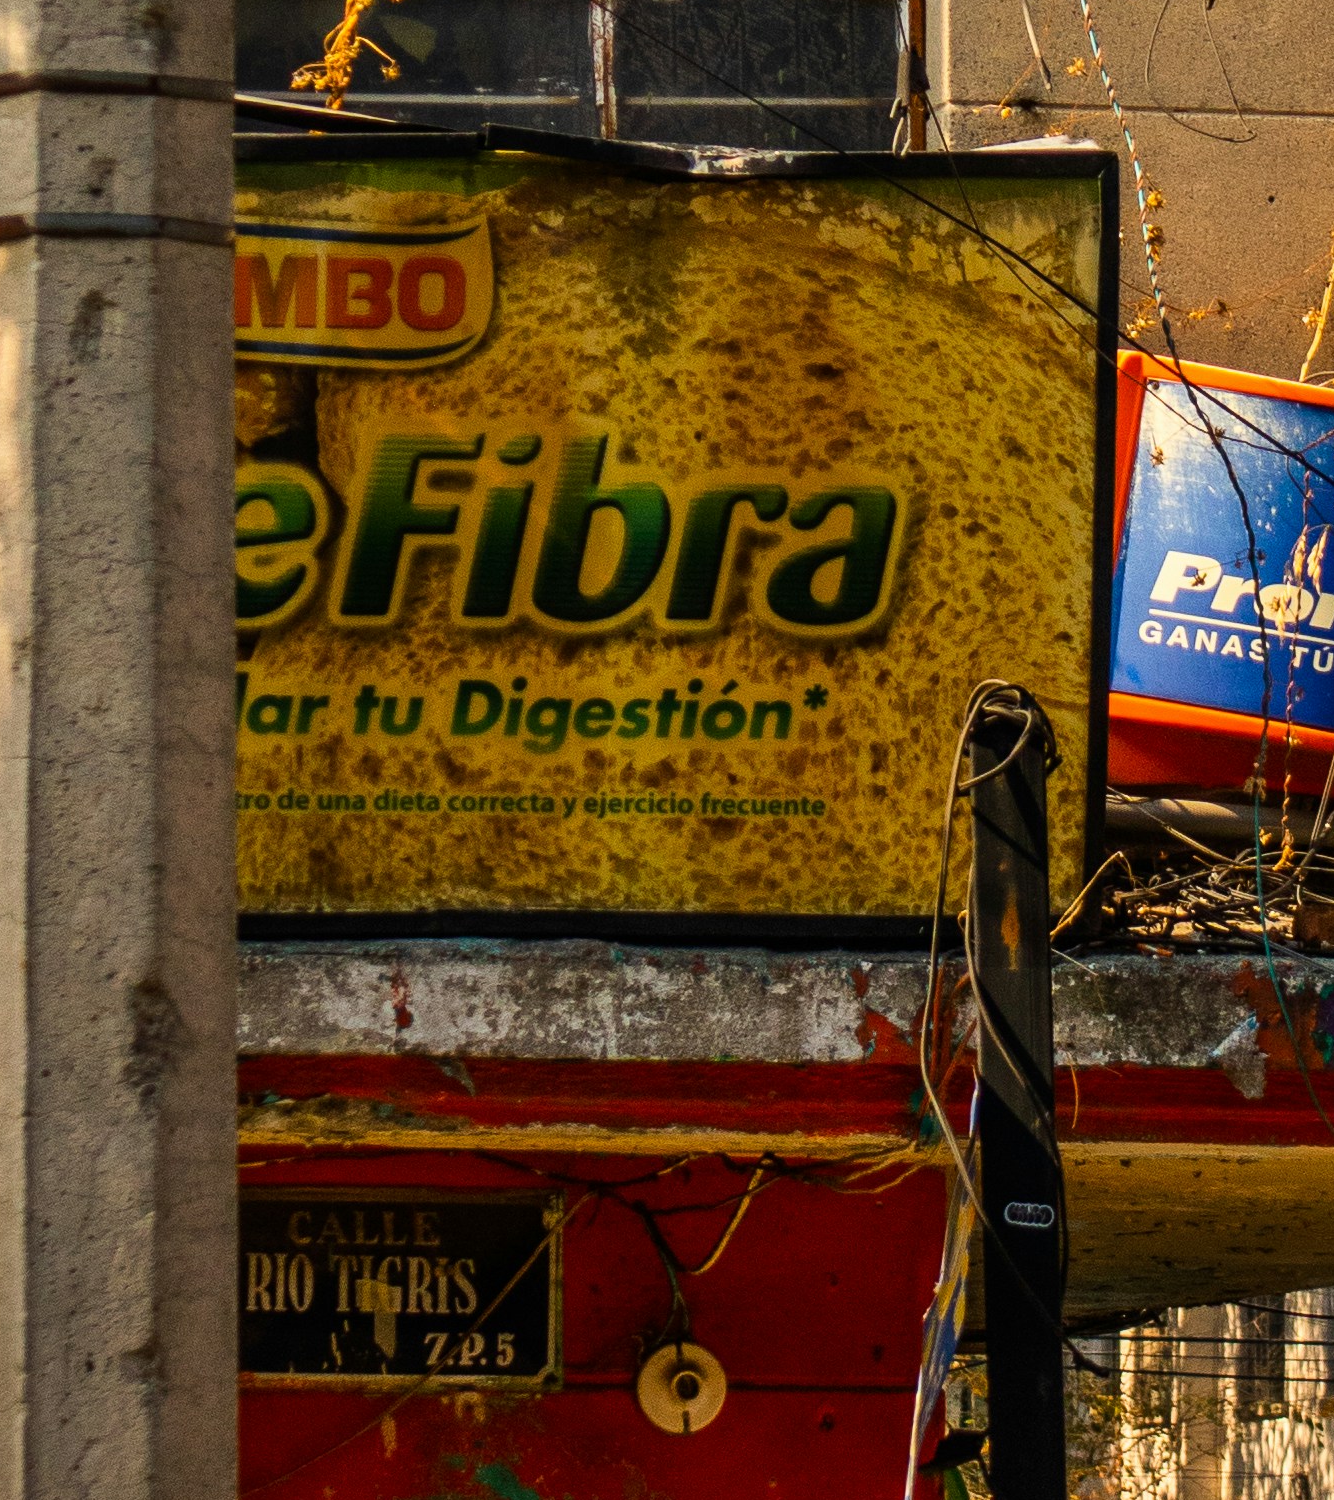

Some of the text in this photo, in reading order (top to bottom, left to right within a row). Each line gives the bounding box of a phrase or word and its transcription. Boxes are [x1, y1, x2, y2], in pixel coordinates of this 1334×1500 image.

[1139, 619, 1272, 662] GANAS
[353, 684, 424, 737] tu
[277, 789, 309, 814] de
[317, 795, 368, 814] una
[373, 790, 441, 814] dieta
[447, 794, 556, 816] correcta
[584, 793, 694, 821] ejercicio
[699, 792, 828, 818] frecuente
[286, 1209, 442, 1247] CALLE
[244, 1252, 479, 1315] RIO TIGRIS
